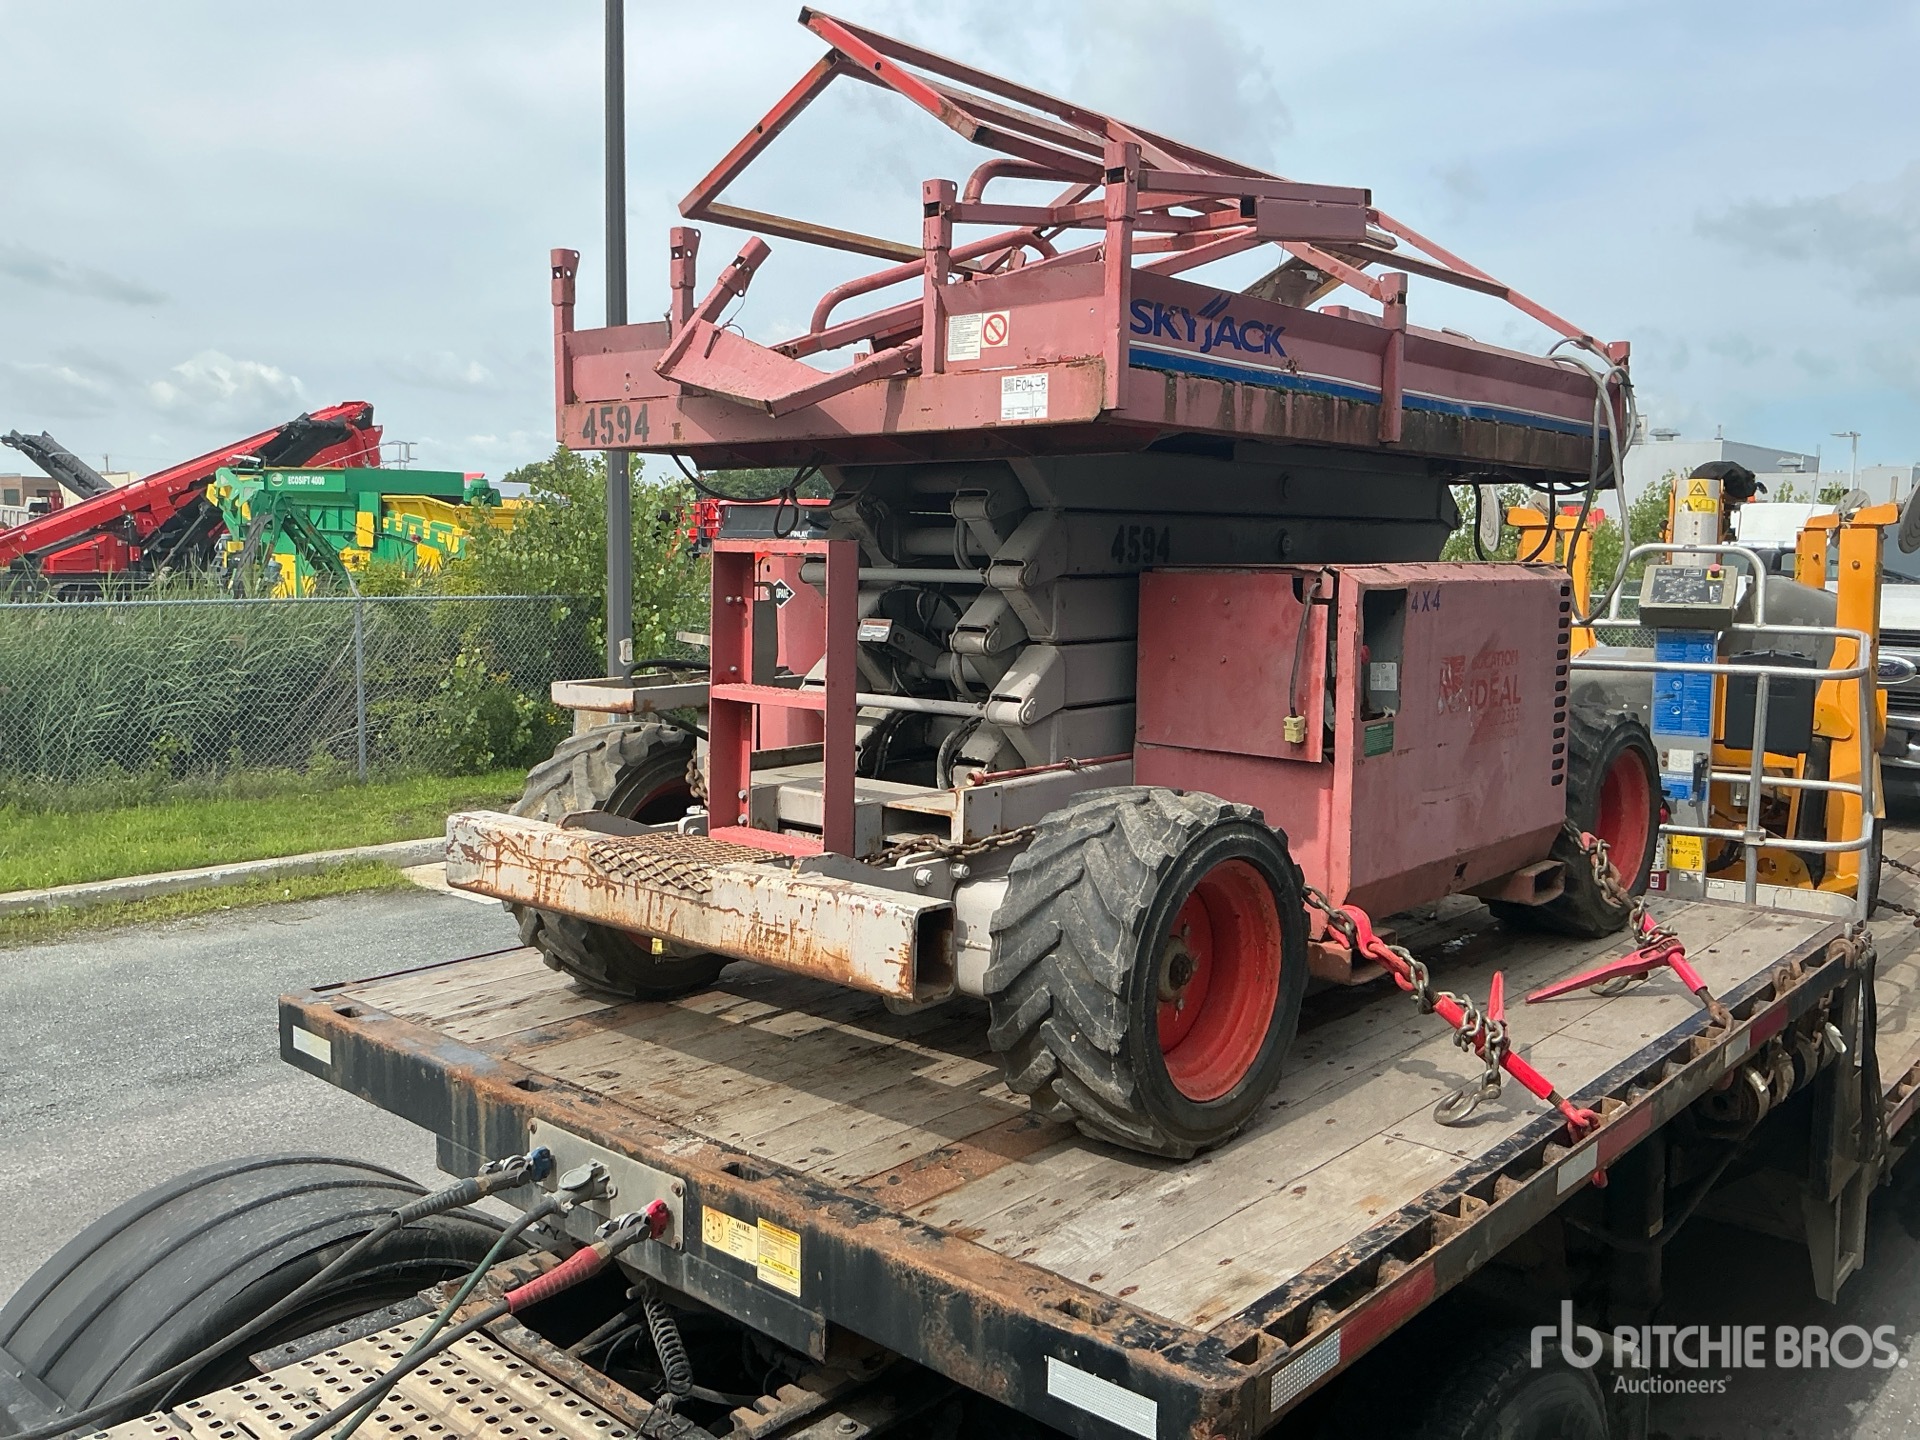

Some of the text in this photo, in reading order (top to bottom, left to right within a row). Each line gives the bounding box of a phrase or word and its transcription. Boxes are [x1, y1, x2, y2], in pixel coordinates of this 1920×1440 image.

[1130, 293, 1288, 358] SKYJACK
[1015, 377, 1046, 391] F04-5
[582, 403, 650, 446] 4594
[287, 475, 311, 486] ECOSIFT
[1110, 524, 1170, 564] 4594
[775, 587, 790, 599] OPANE
